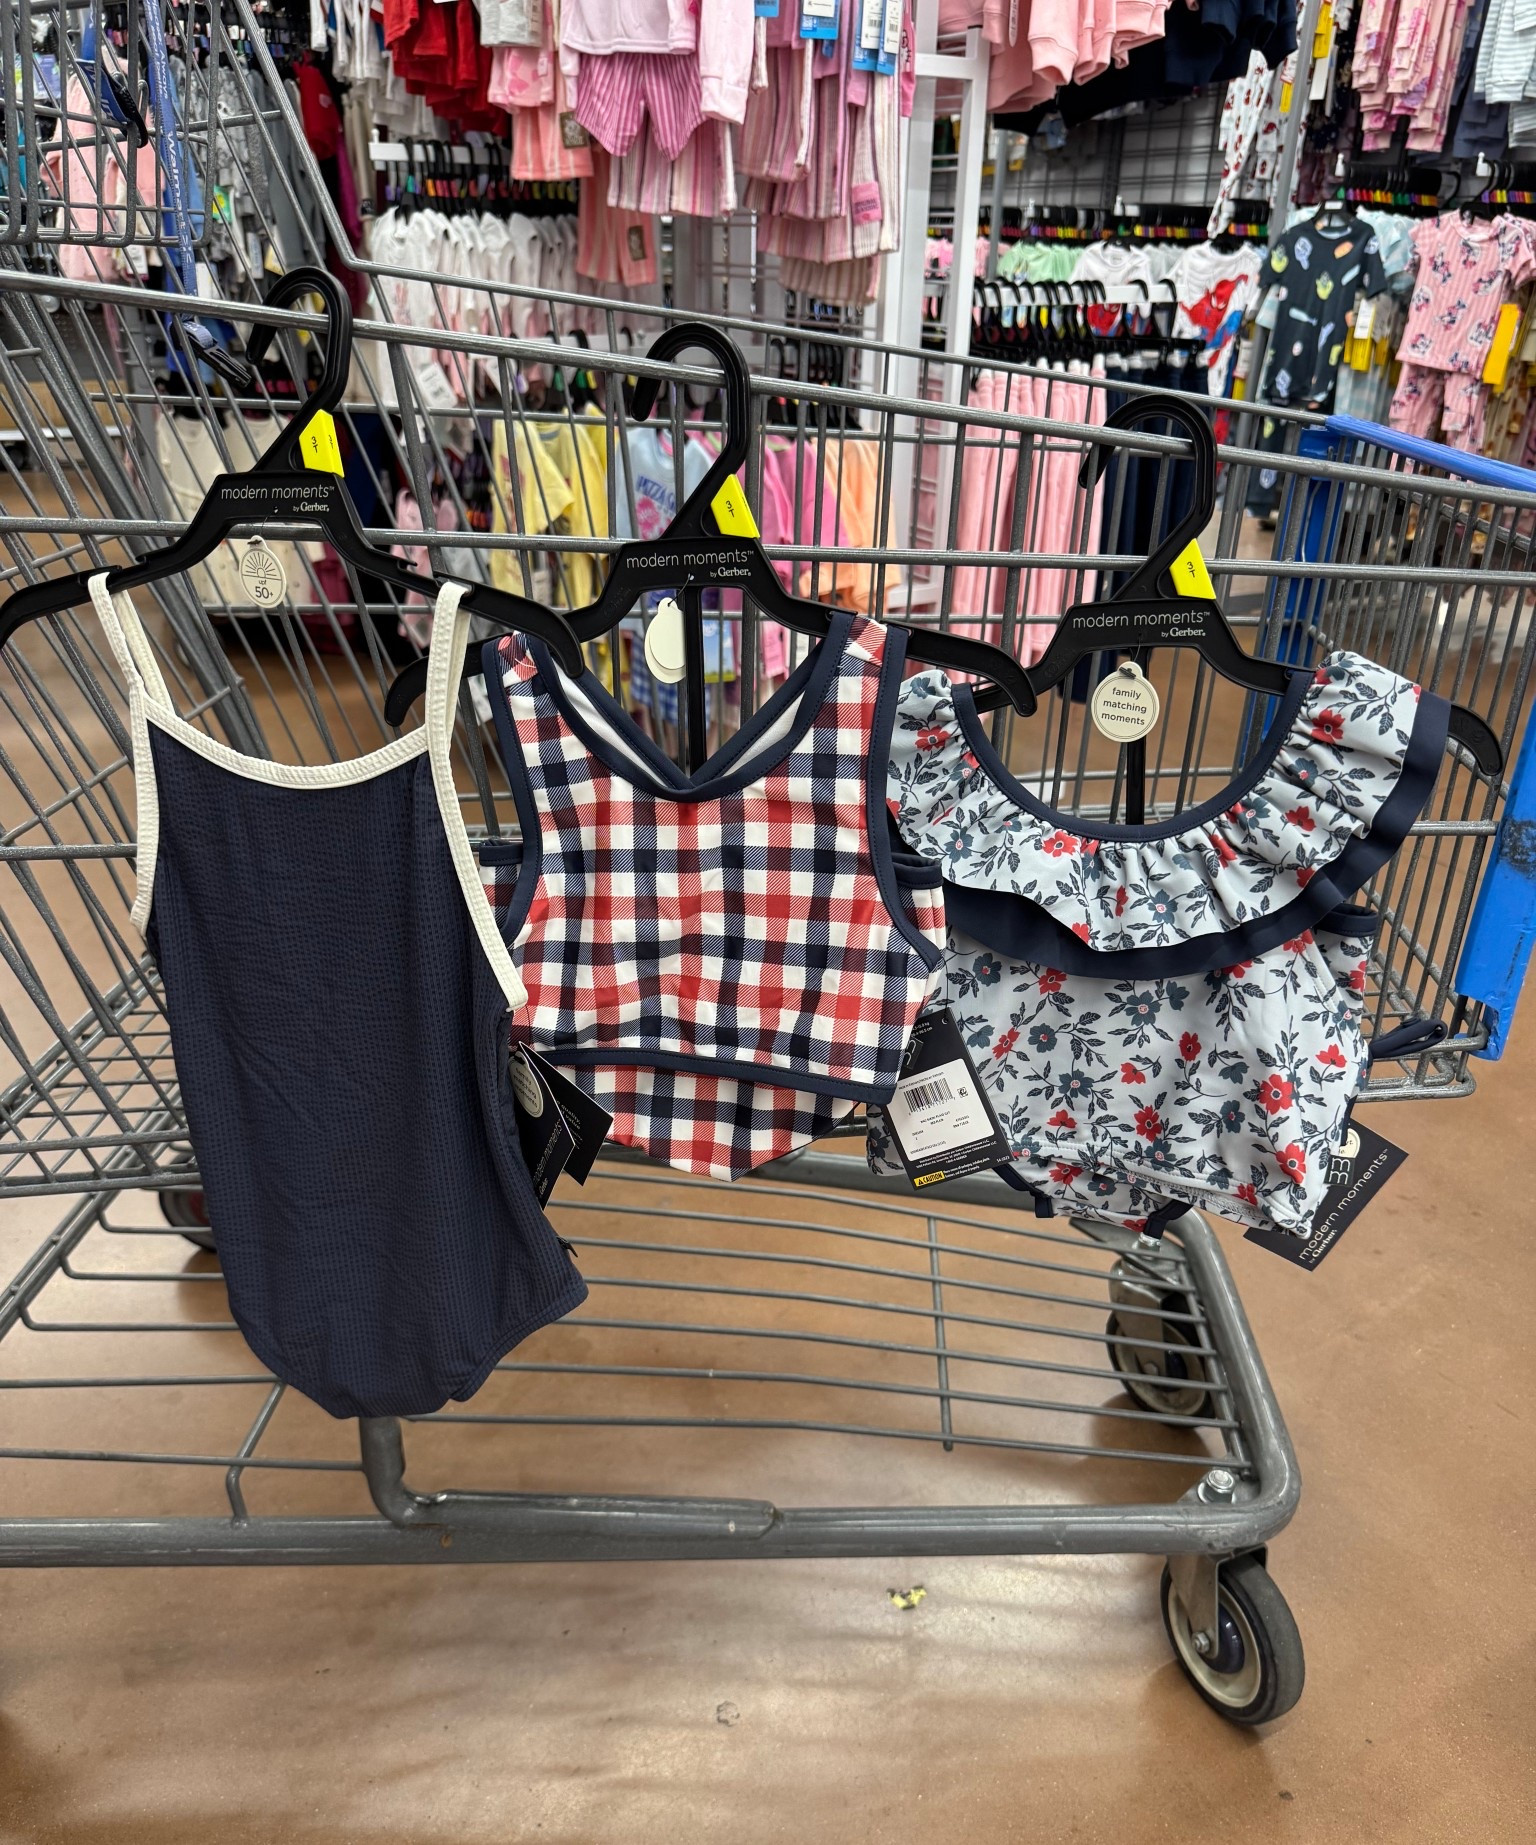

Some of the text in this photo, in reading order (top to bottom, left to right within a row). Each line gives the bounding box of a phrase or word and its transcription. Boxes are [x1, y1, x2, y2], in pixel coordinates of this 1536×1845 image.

[167, 131, 186, 229] Walmart
[222, 485, 268, 500] modern
[626, 552, 679, 568] modern
[254, 586, 274, 599] 50+
[1073, 613, 1129, 628] modern
[1112, 686, 1142, 700] family
[1103, 700, 1147, 714] matching
[1101, 712, 1145, 726] moments
[922, 1172, 943, 1183] CAUTION
[1298, 1212, 1340, 1261] modern
